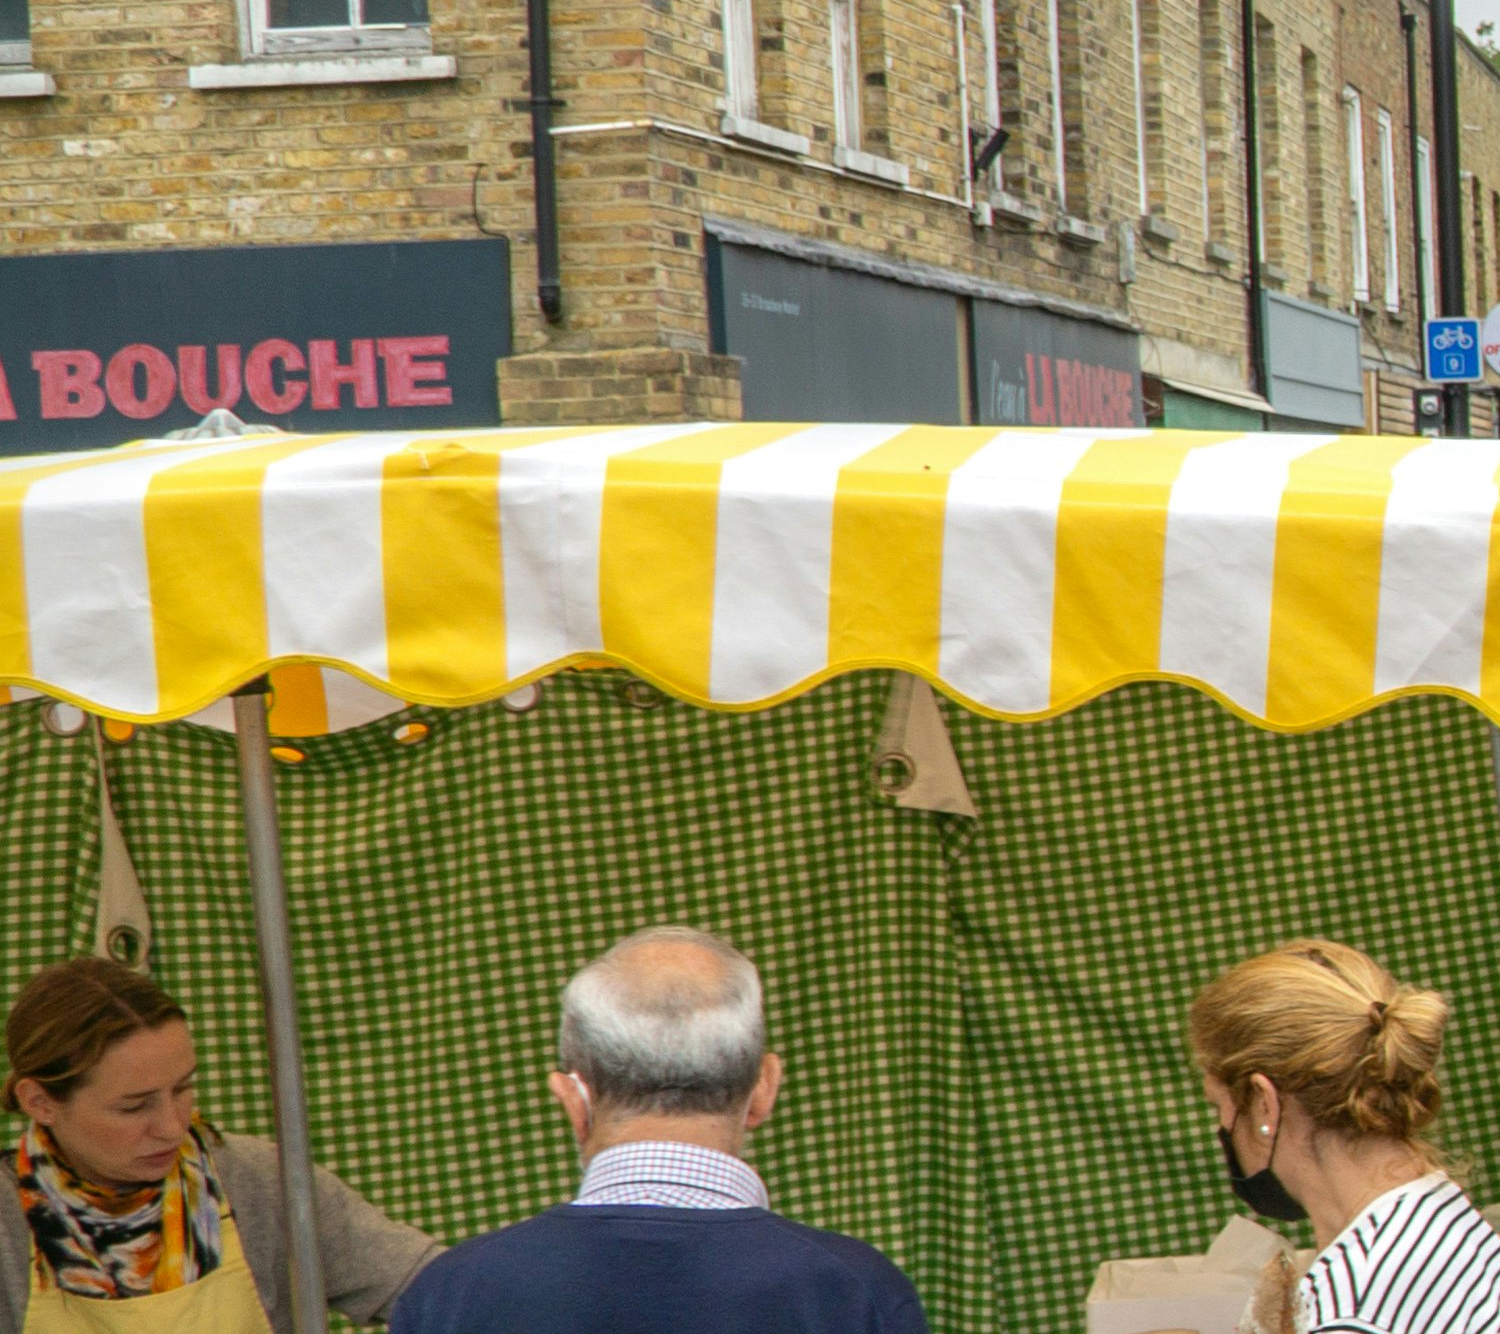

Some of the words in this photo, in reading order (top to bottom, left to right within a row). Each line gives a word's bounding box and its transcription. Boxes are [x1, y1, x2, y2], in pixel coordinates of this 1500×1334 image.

[31, 334, 454, 420] BOUCHE
[1025, 352, 1057, 426] LA
[1056, 358, 1136, 427] BOUCHE
